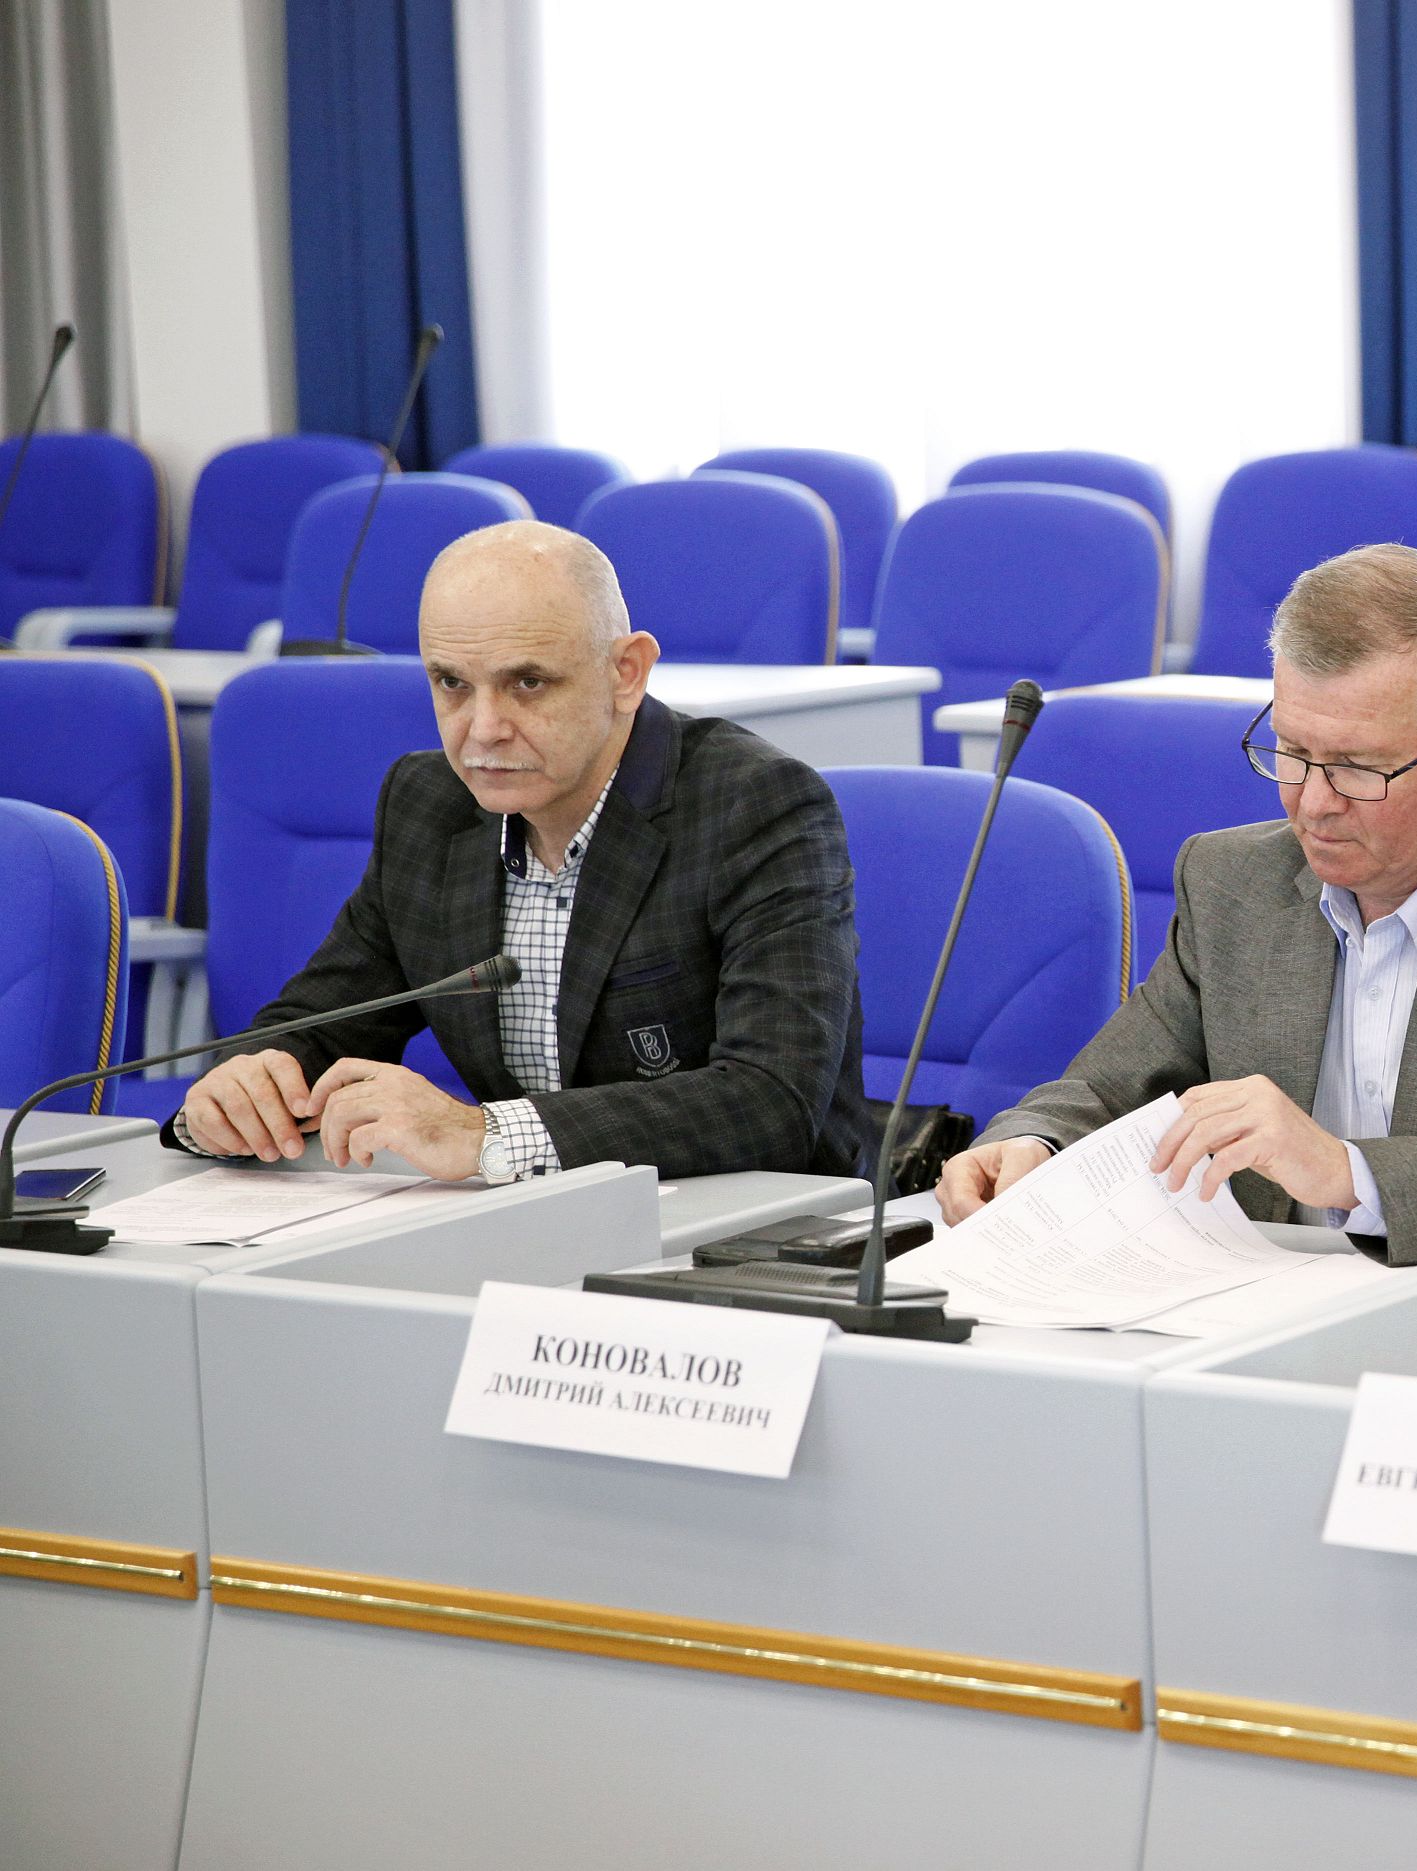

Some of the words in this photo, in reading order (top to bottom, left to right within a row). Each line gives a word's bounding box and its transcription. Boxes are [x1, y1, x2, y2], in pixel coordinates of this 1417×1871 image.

[531, 1334, 744, 1388] КОНОВАЛОВ
[483, 1372, 605, 1407] ДМИТРИЙ
[610, 1391, 772, 1429] АЛЕКСЕЕВИЧ
